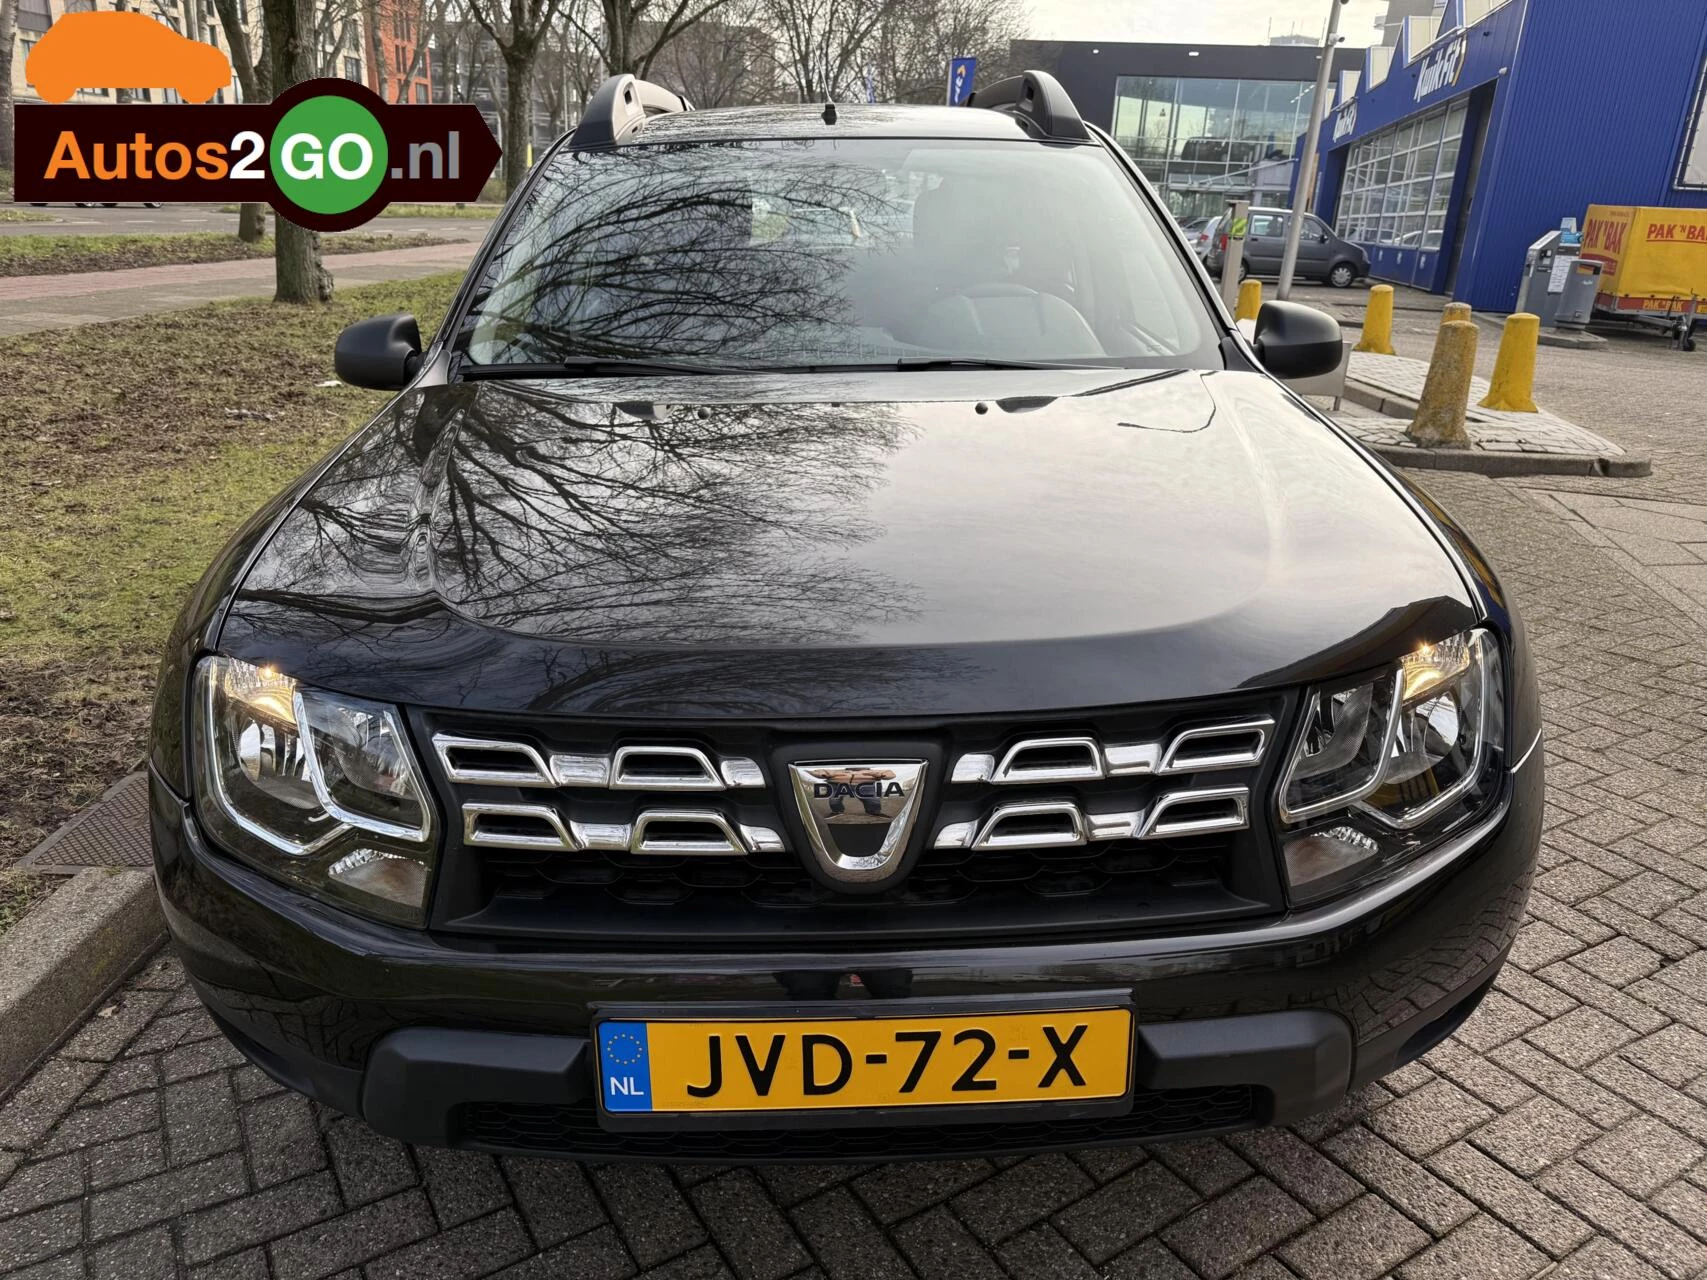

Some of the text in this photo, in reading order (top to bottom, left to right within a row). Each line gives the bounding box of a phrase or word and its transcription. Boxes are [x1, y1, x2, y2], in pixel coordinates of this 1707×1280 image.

[1647, 223, 1677, 239] PAK
[1686, 224, 1707, 241] BA
[814, 782, 905, 798] DACIA
[686, 1024, 1088, 1098] JVD-72-X
[609, 1076, 644, 1097] NL
